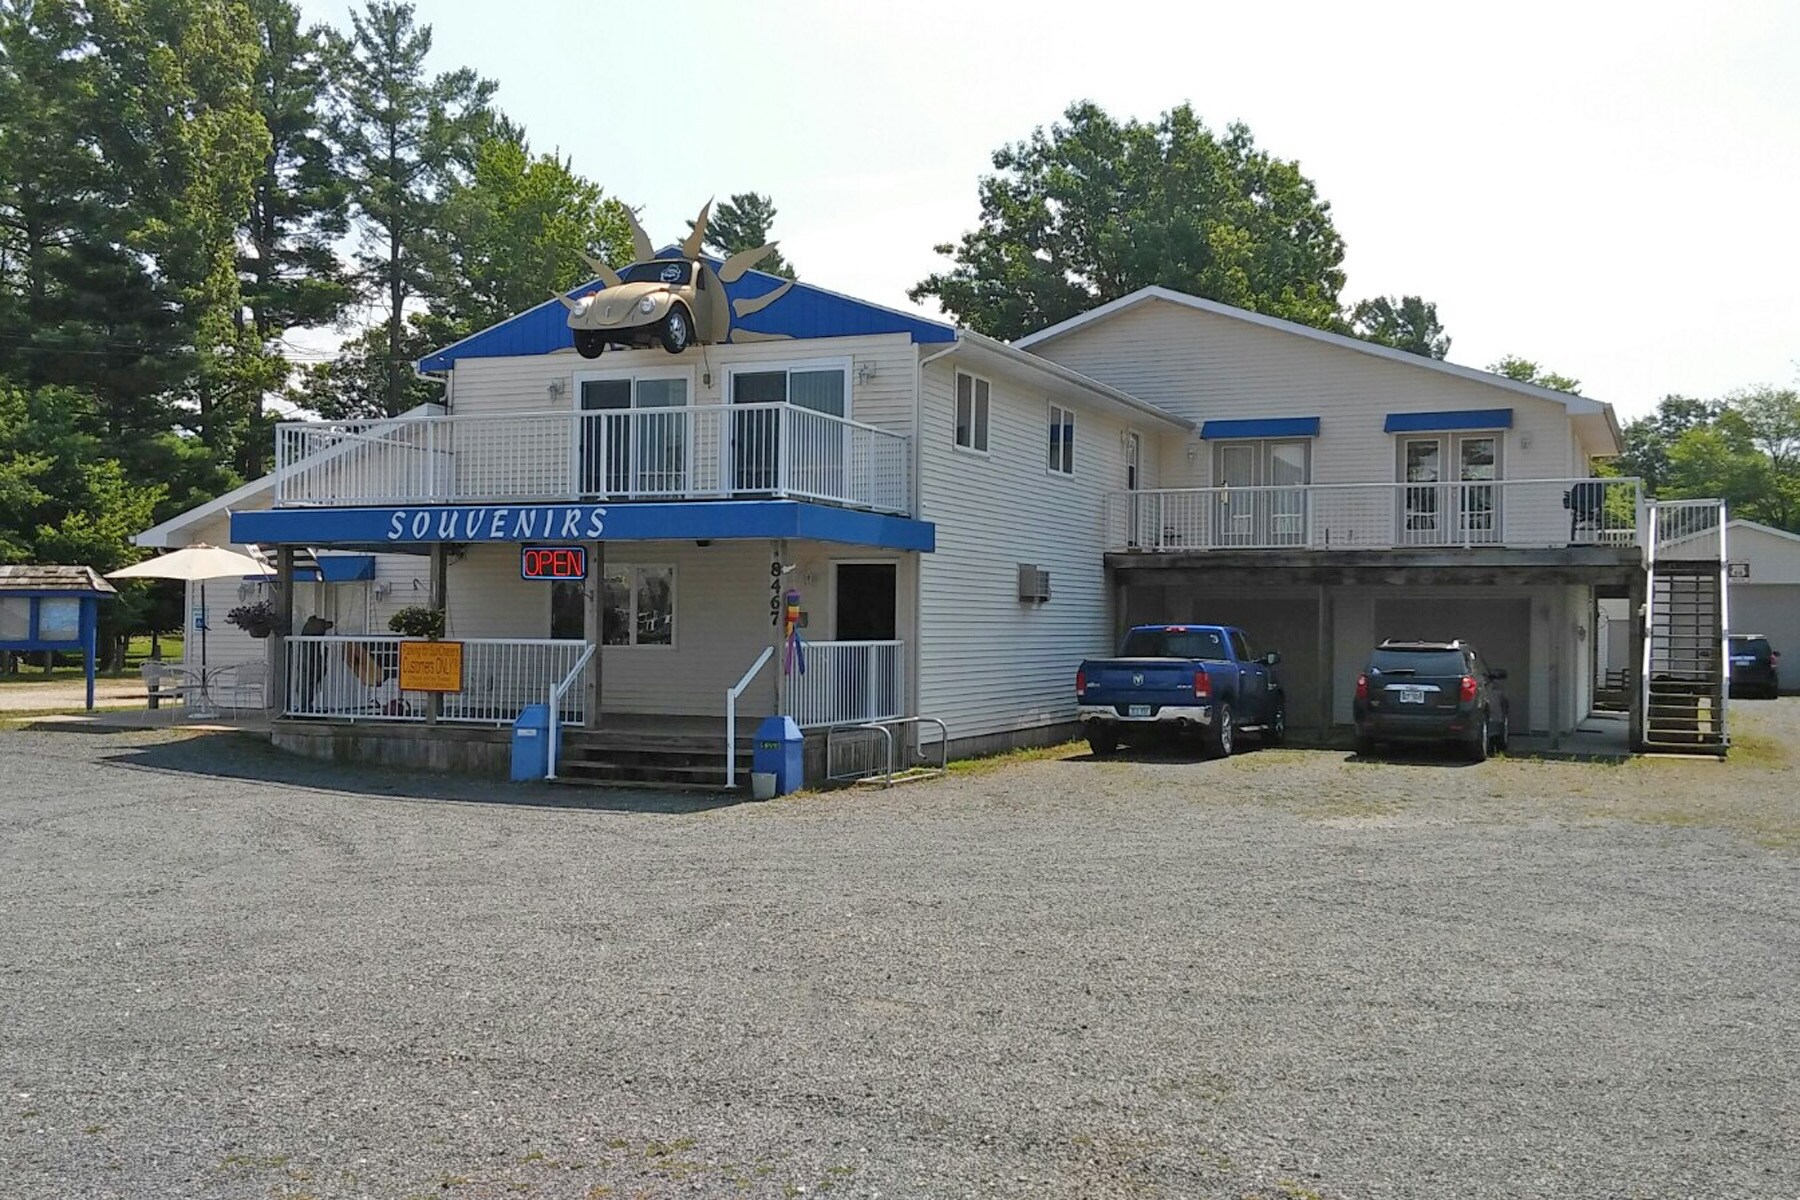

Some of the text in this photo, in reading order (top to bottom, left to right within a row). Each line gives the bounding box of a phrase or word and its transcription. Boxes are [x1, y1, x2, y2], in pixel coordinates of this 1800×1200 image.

[387, 507, 607, 540] SOUVENIRS
[524, 549, 583, 577] OPEN
[770, 562, 782, 626] 8467
